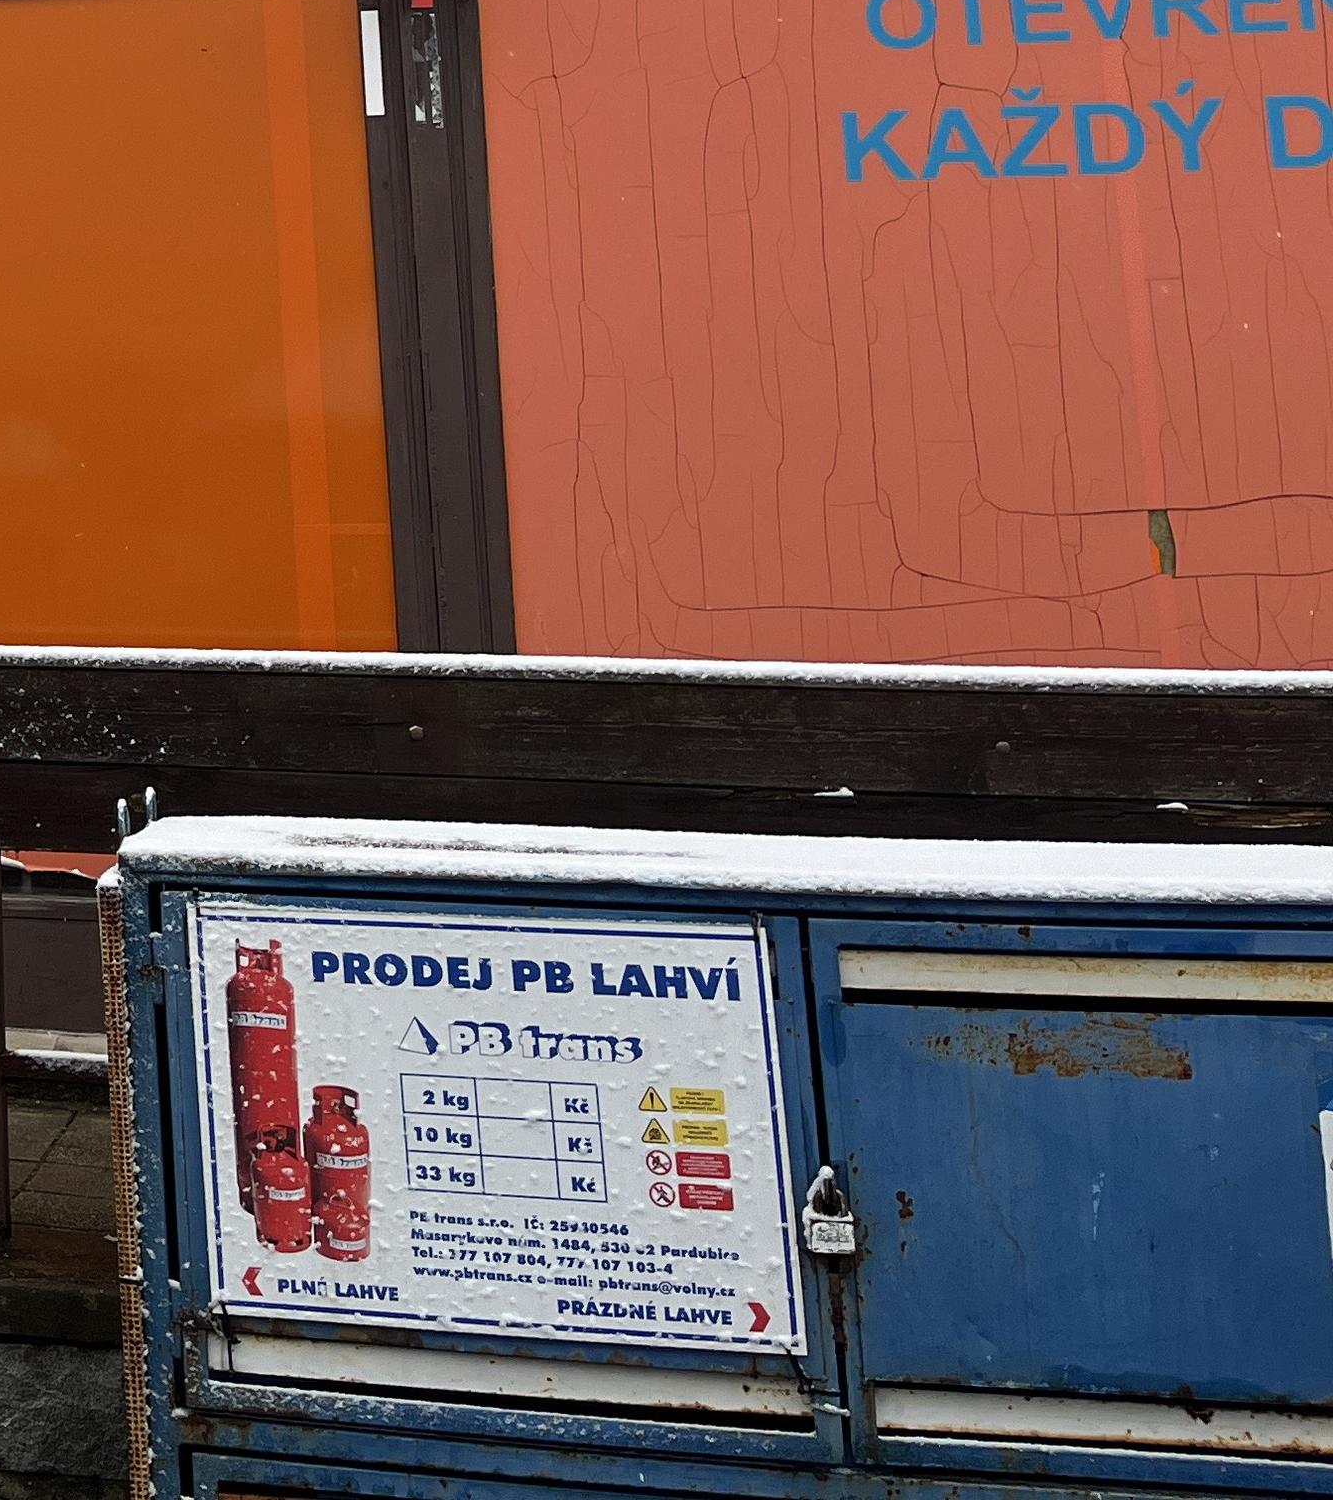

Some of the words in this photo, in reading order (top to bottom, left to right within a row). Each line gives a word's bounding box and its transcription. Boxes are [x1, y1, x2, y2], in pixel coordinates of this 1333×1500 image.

[840, 79, 1223, 183] KAŽDÝ
[311, 951, 493, 991] PRODEJ
[511, 959, 574, 994] PB
[590, 957, 741, 1001] LAHVÍ
[448, 1020, 513, 1056] PB
[518, 1025, 644, 1064] trans
[423, 1090, 435, 1105] 2
[443, 1090, 470, 1111] kg
[565, 1097, 590, 1114] Kč
[413, 1126, 438, 1143] 10
[446, 1127, 473, 1148] kg
[415, 1165, 441, 1181] 33
[449, 1166, 475, 1187] kg
[434, 1212, 473, 1226] trans
[477, 1218, 514, 1229] s.r.o.
[552, 1237, 596, 1254] 1484,
[412, 1246, 443, 1260] Tel.:
[483, 1251, 512, 1263] 107
[517, 1254, 552, 1268] 804,
[593, 1258, 621, 1271] 107
[627, 1260, 673, 1274] 103-4
[334, 1282, 399, 1302] LAHVE
[413, 1267, 533, 1284] www.pbtrans.cz
[537, 1275, 593, 1288] e-mail:
[599, 1277, 736, 1298] pbtrans@volny.cz
[557, 1296, 657, 1321] PRÁZDNÉ
[664, 1306, 733, 1326] LAHVE
